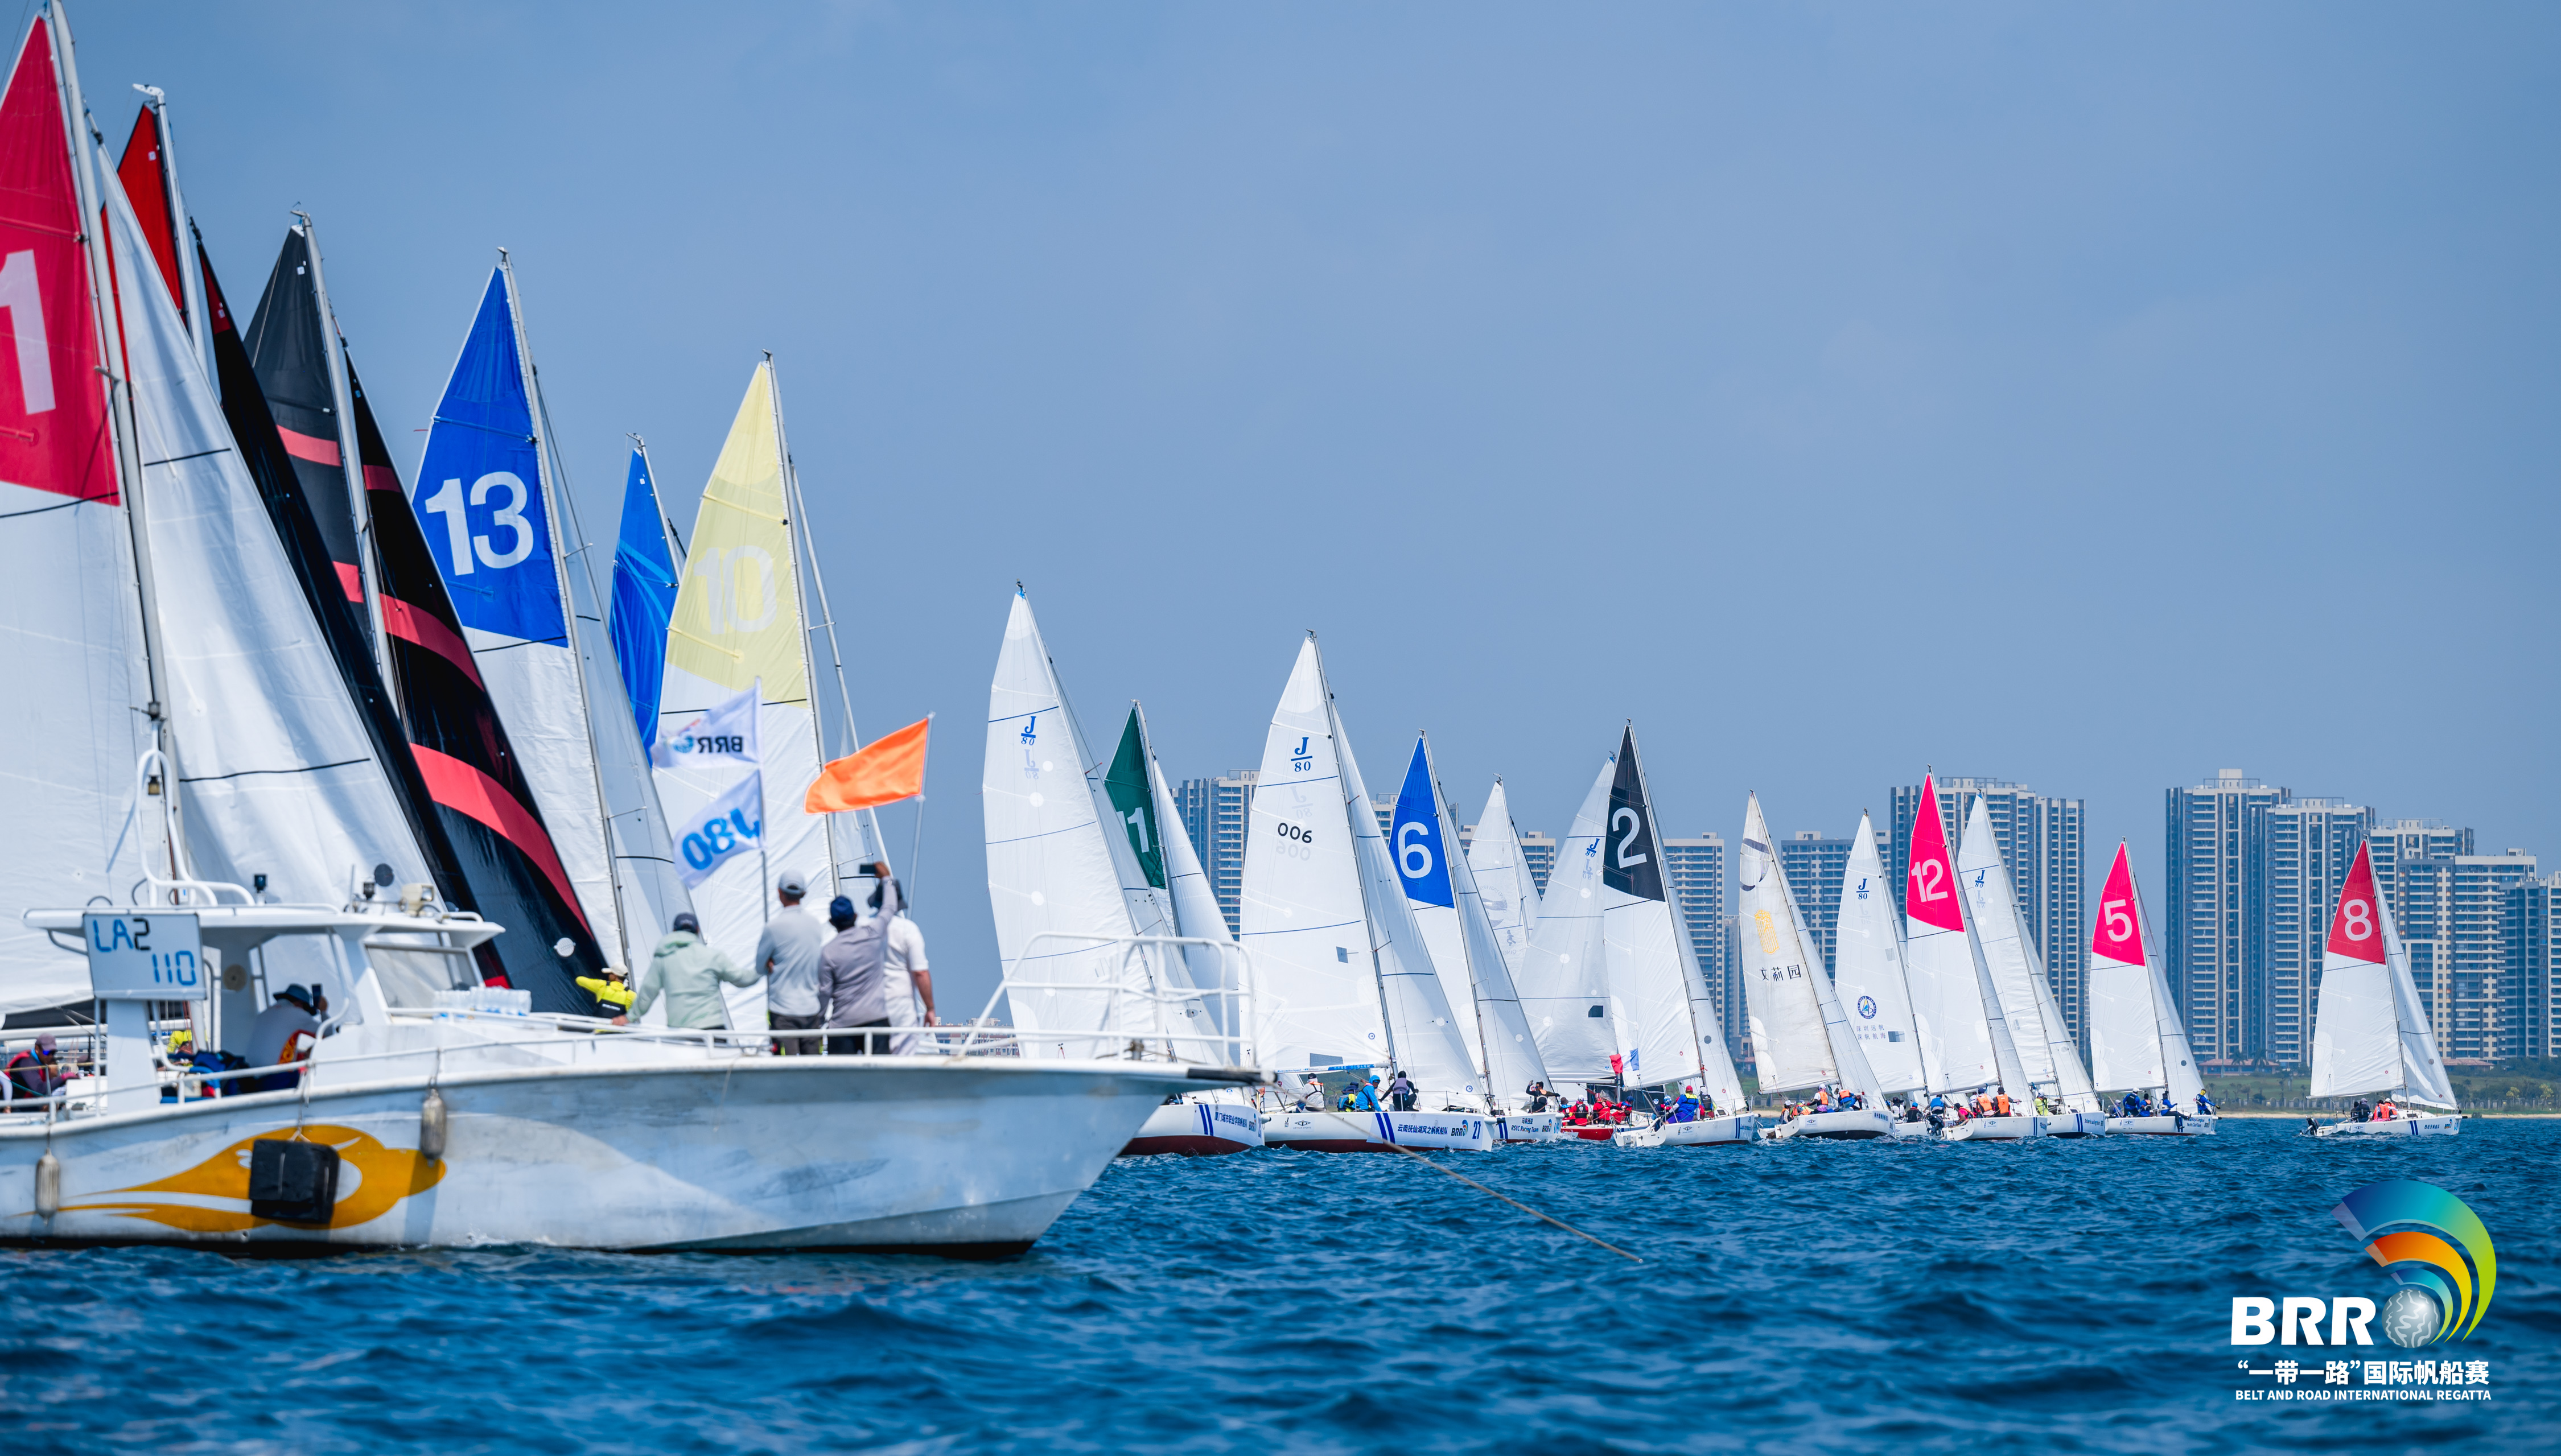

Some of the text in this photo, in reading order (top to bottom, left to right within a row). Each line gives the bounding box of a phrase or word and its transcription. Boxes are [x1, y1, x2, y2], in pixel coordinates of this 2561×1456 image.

[425, 471, 534, 576] 13
[693, 544, 778, 637] 10
[1024, 716, 1036, 734] J
[1020, 737, 1035, 746] 80
[1294, 737, 1310, 756] J
[1294, 761, 1311, 772] 80
[1277, 822, 1313, 844] 006
[1589, 838, 1600, 849] J
[1612, 807, 1648, 869] 2
[1397, 821, 1432, 879] 6
[1858, 878, 1868, 890] J
[1911, 859, 1949, 903] 12
[1977, 869, 1986, 881] J
[2103, 899, 2133, 942] 5
[2343, 899, 2373, 941] 8
[93, 917, 151, 952] LA2
[152, 950, 197, 986] 110
[1397, 1124, 1448, 1135] 云南抚仙湖风之帆帆船队
[1451, 1127, 1463, 1137] BRR
[1472, 1120, 1481, 1140] 27
